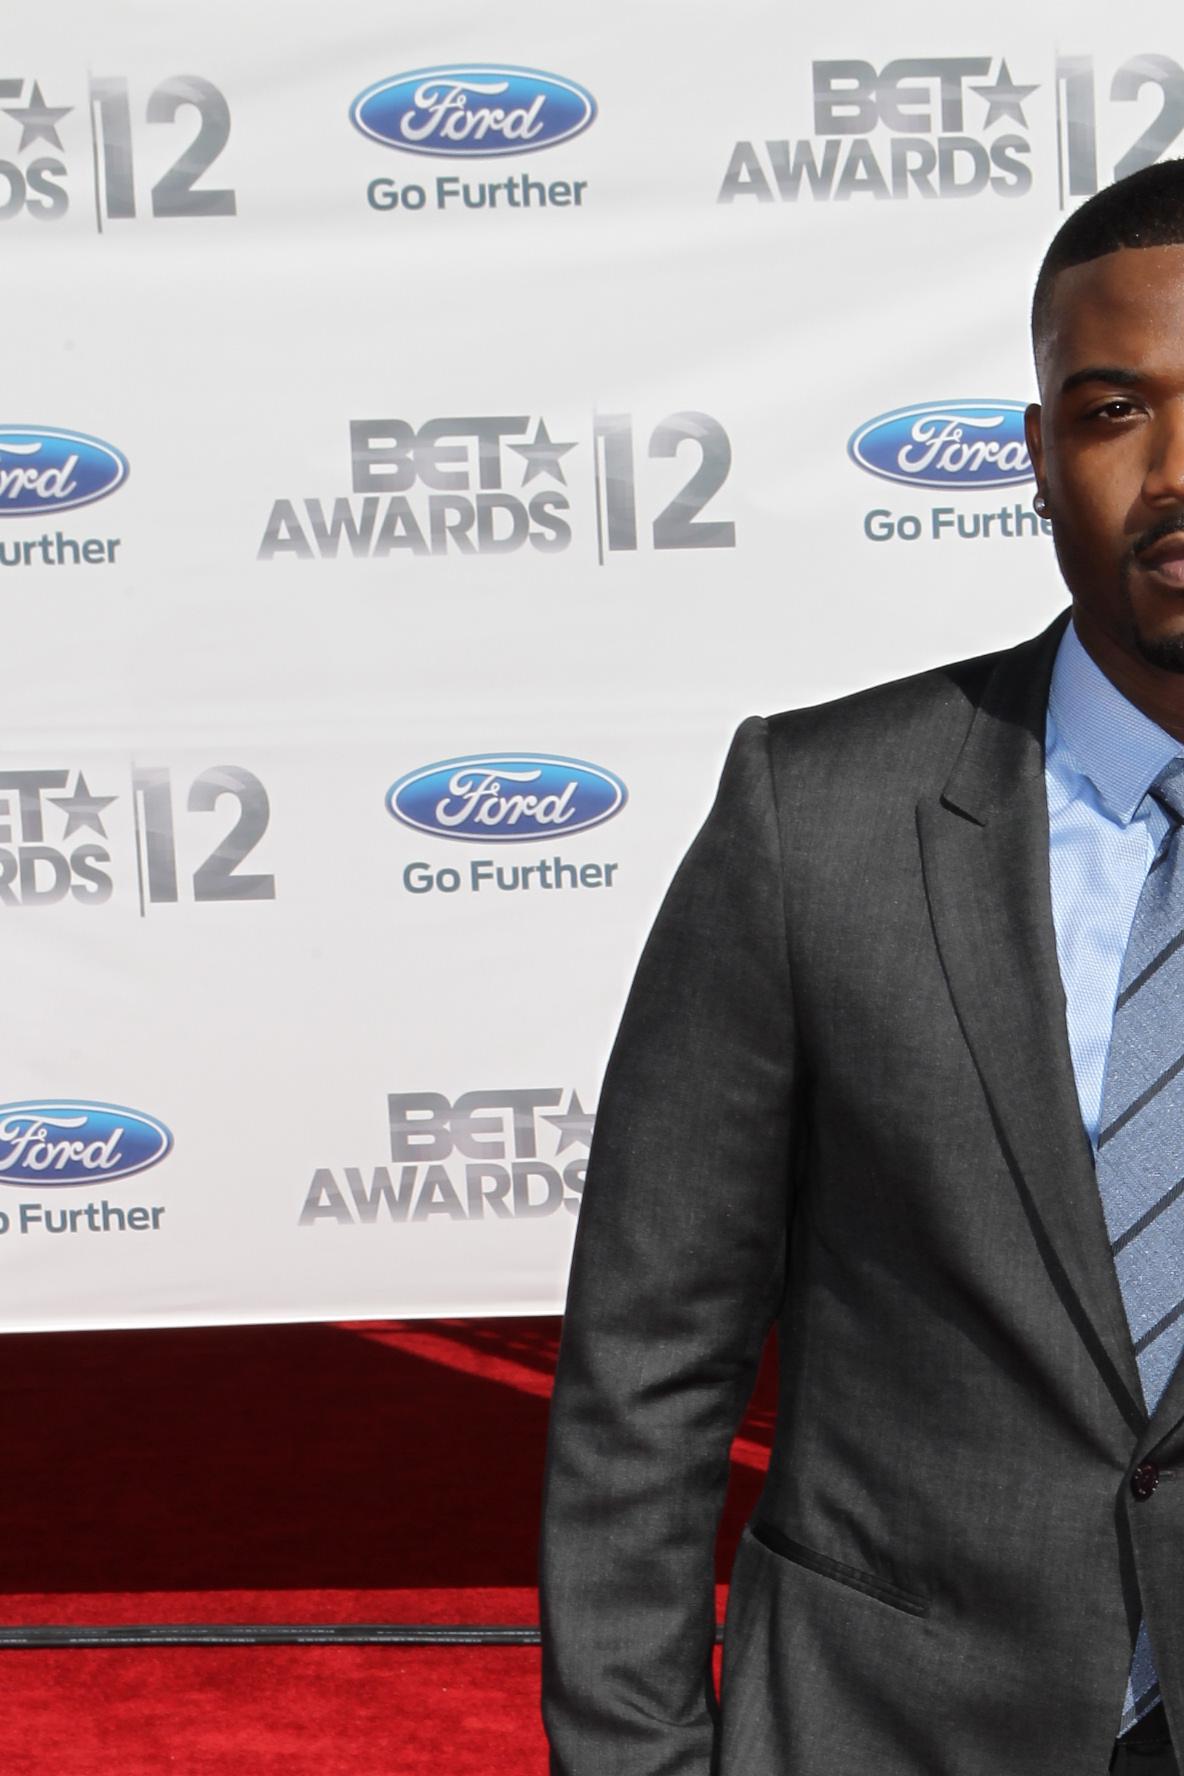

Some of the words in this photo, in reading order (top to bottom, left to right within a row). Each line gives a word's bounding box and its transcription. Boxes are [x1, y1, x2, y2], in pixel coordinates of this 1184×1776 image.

[401, 79, 545, 141] Ford
[811, 56, 993, 136] BET
[90, 74, 237, 219] 12
[717, 135, 1033, 205] AWARDS
[366, 178, 427, 212] Go
[436, 173, 588, 210] Further
[349, 416, 532, 495] BET
[595, 410, 737, 553] 12
[0, 531, 121, 567] urther
[256, 491, 573, 562] AWARDS
[864, 508, 922, 542] Go
[931, 503, 1054, 540] Furth
[435, 768, 578, 826] Ford
[134, 764, 277, 903] 12
[402, 862, 462, 895] Go
[470, 856, 618, 892] Further
[0, 1114, 124, 1172] Ford
[387, 1088, 564, 1164] BET
[18, 1200, 166, 1235] Further
